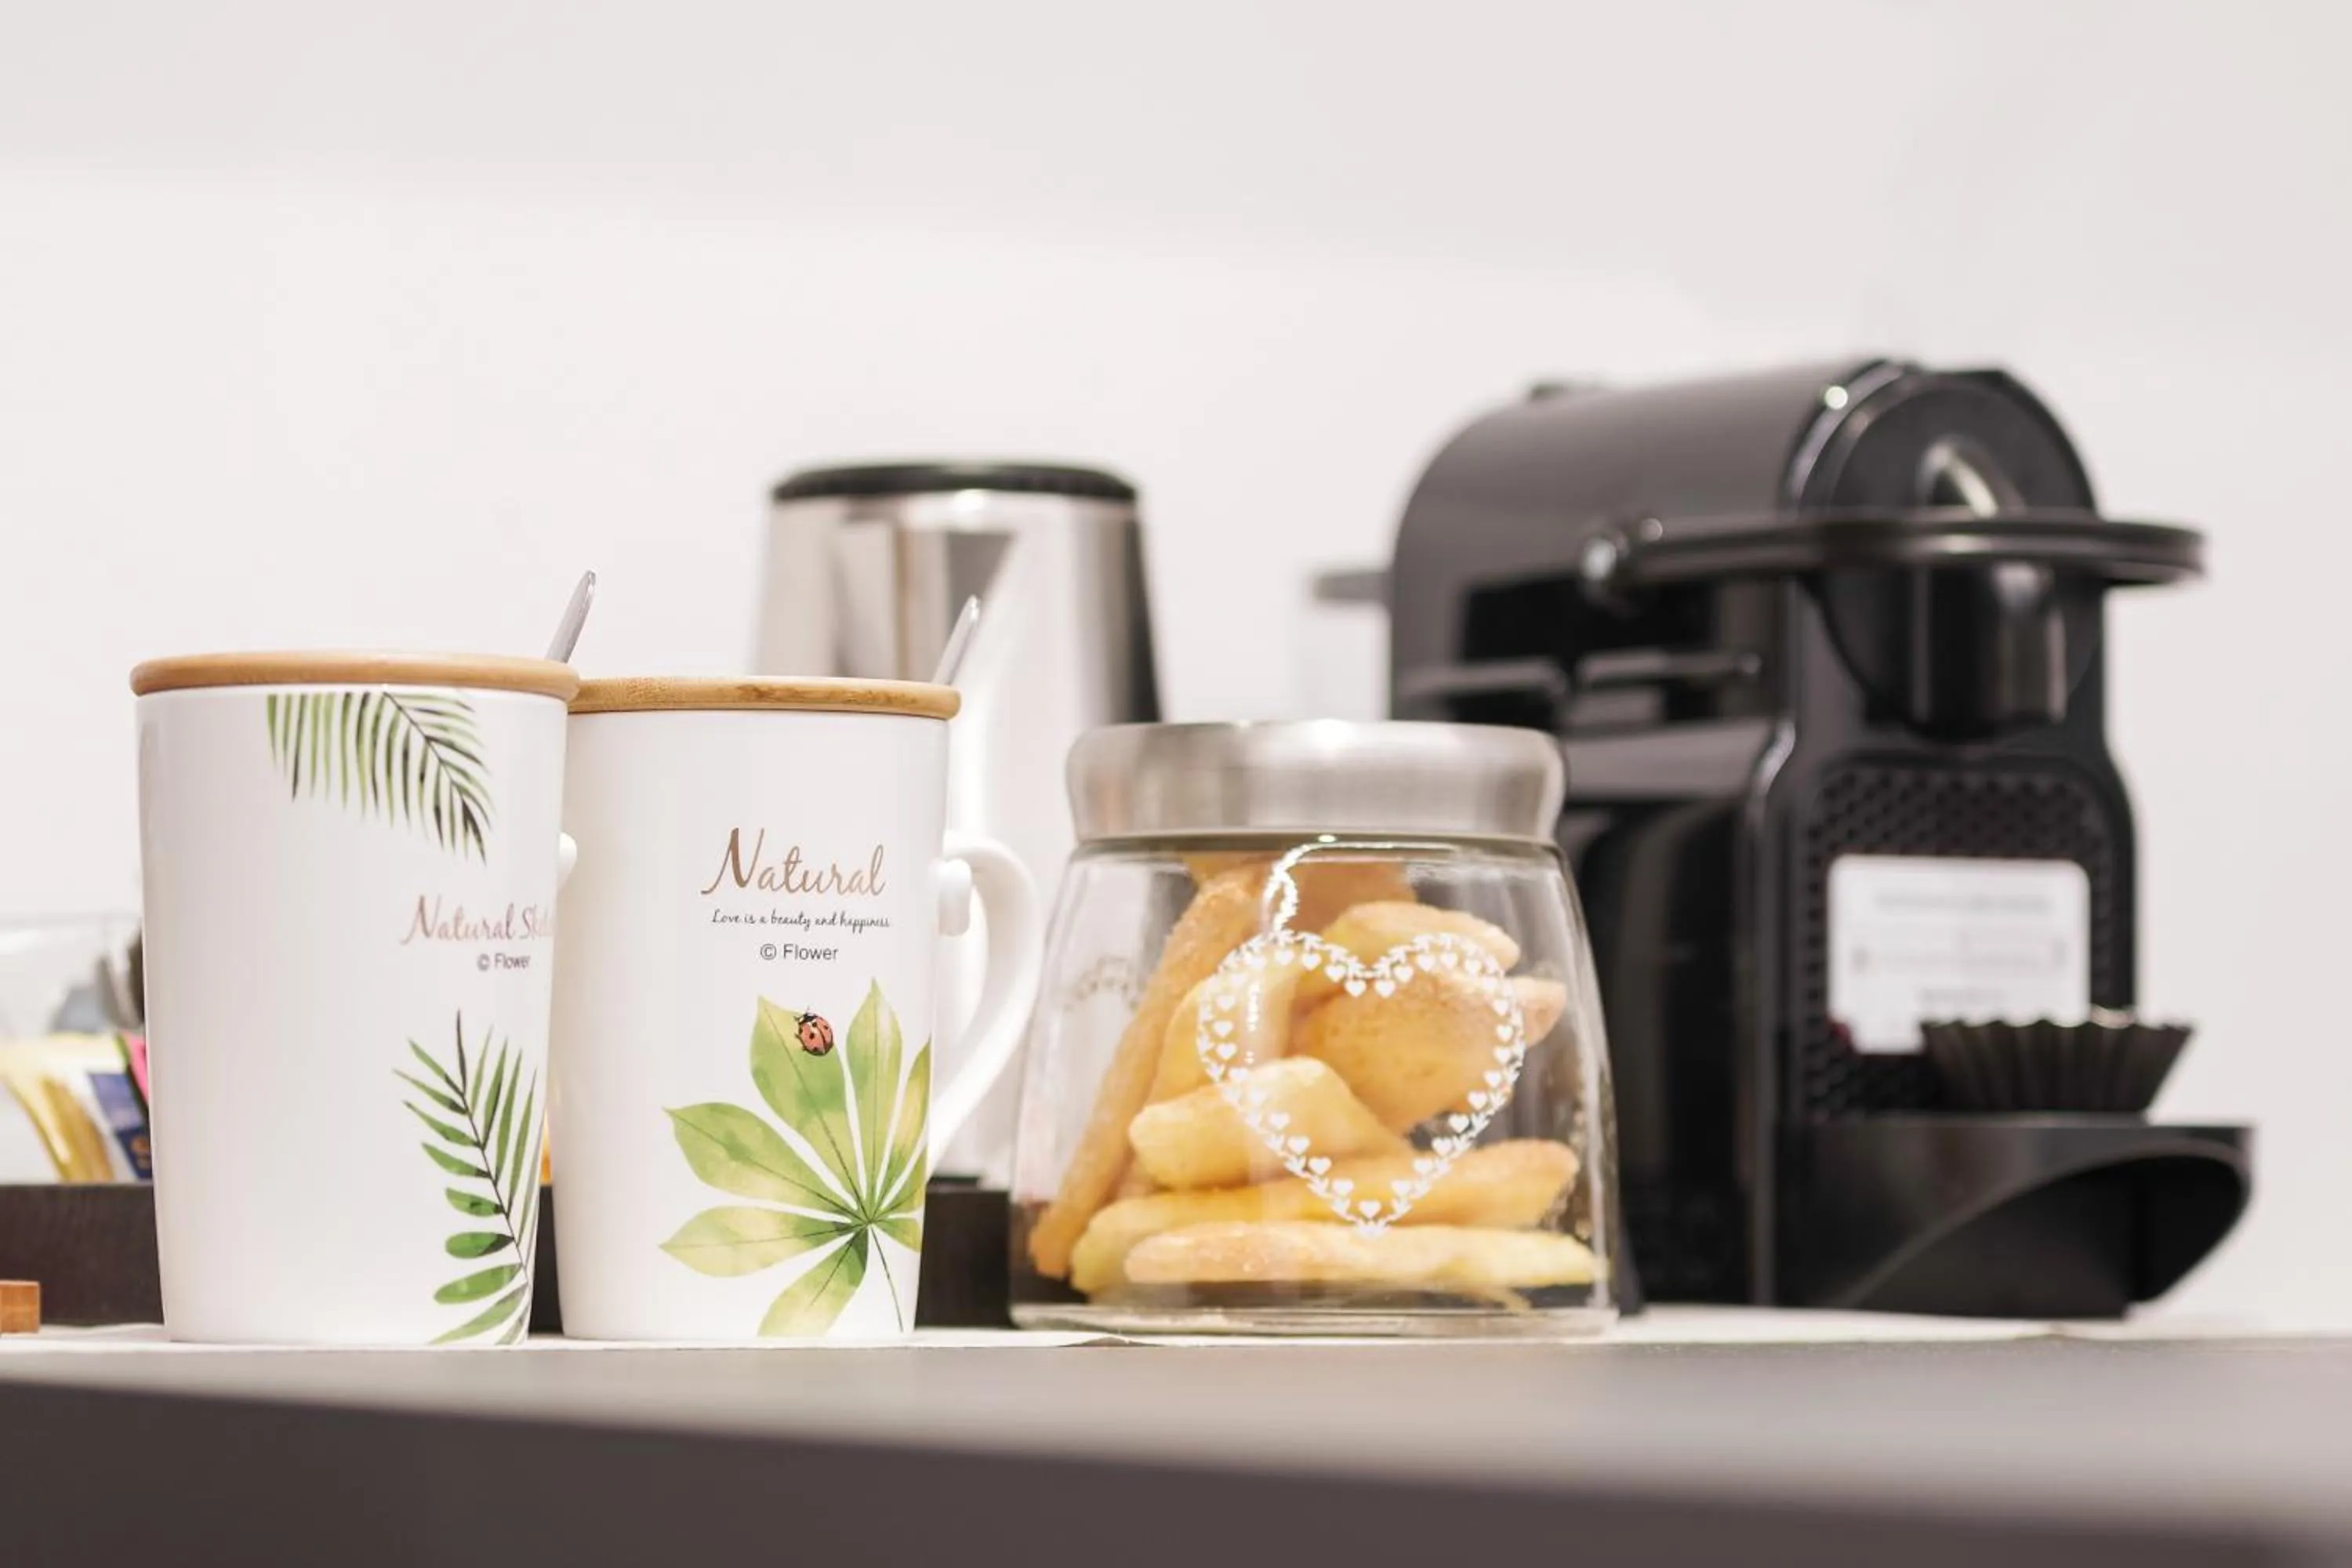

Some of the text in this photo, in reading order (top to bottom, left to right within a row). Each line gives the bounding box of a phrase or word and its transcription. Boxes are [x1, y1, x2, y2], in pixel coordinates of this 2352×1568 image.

[700, 826, 886, 896] Natural
[399, 893, 516, 946] Natural
[711, 908, 891, 935] Love is a beauty and happiness
[494, 953, 531, 970] Flower
[782, 943, 839, 960] Flower
